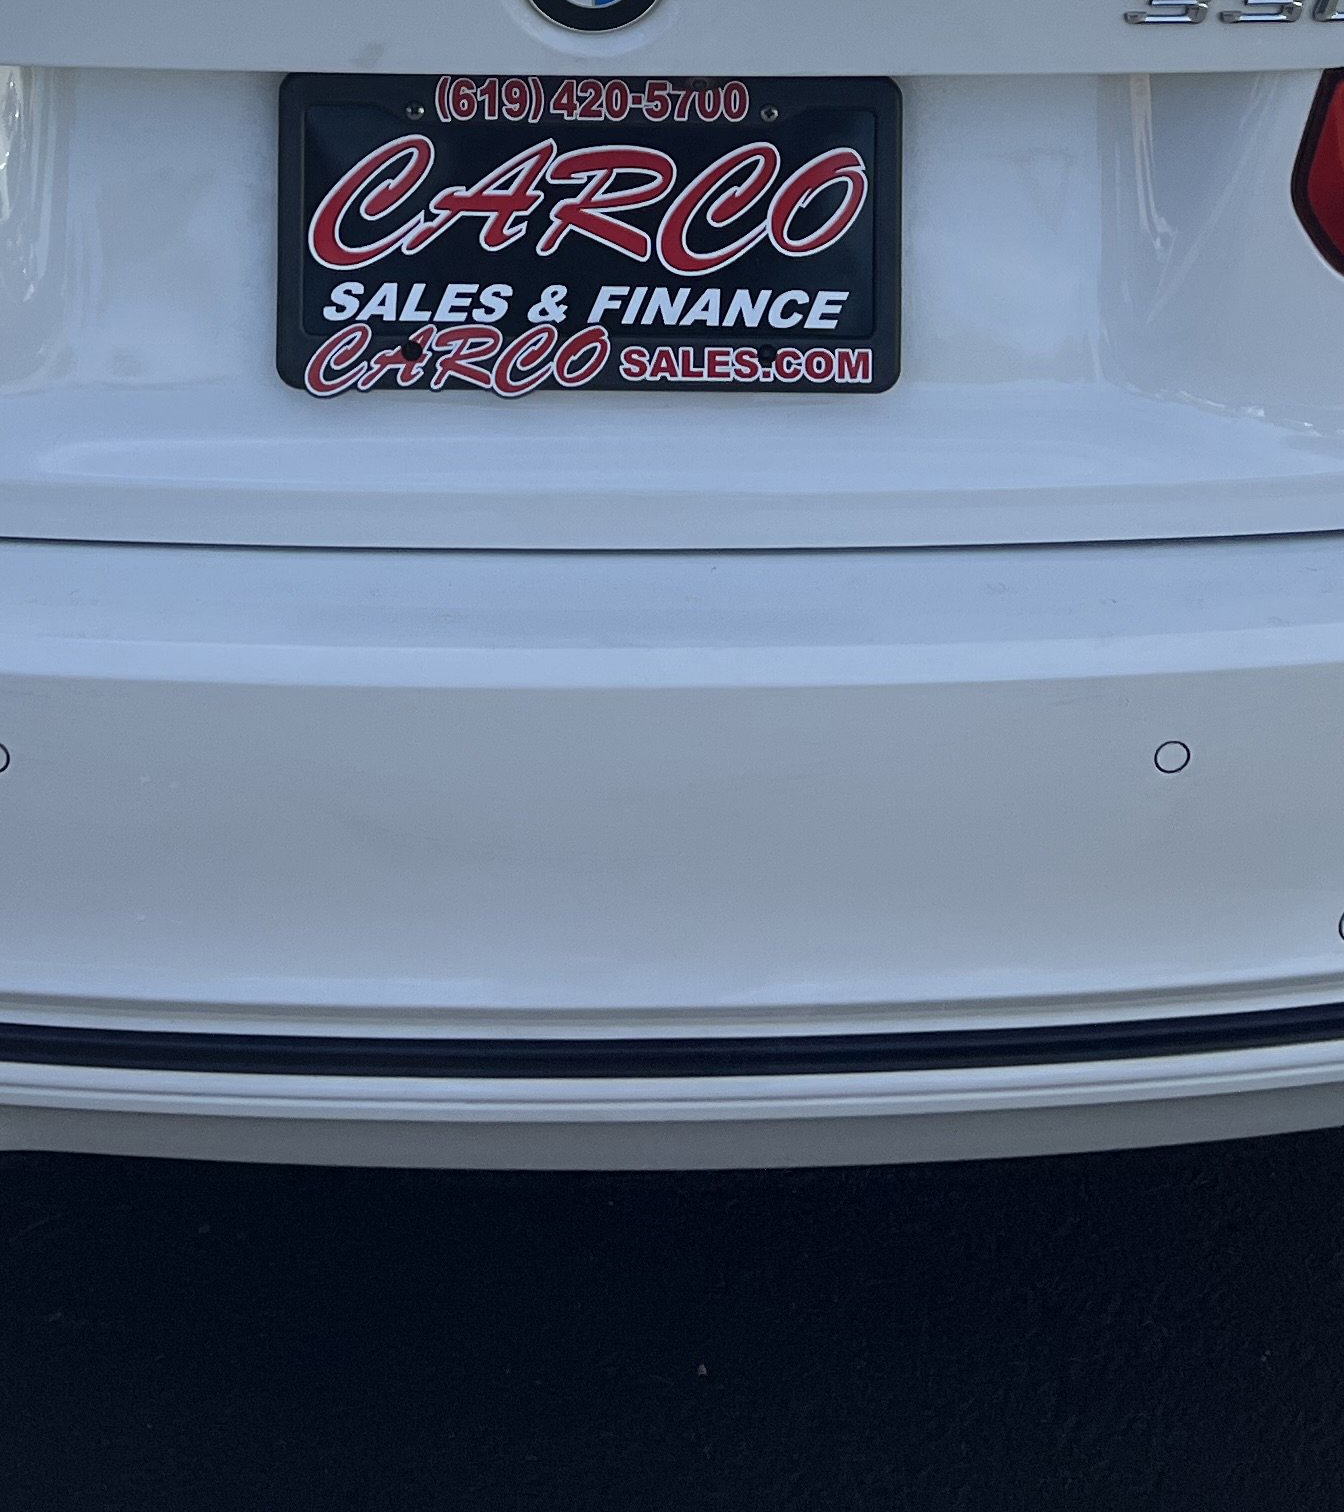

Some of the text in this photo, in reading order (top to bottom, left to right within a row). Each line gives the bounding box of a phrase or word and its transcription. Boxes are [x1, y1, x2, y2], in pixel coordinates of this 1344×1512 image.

[435, 76, 750, 123] (619) 420-5700
[308, 134, 868, 276] CARCO
[323, 281, 850, 330] SALES & FINANCE
[305, 323, 873, 397] CARCO SALES.COM
